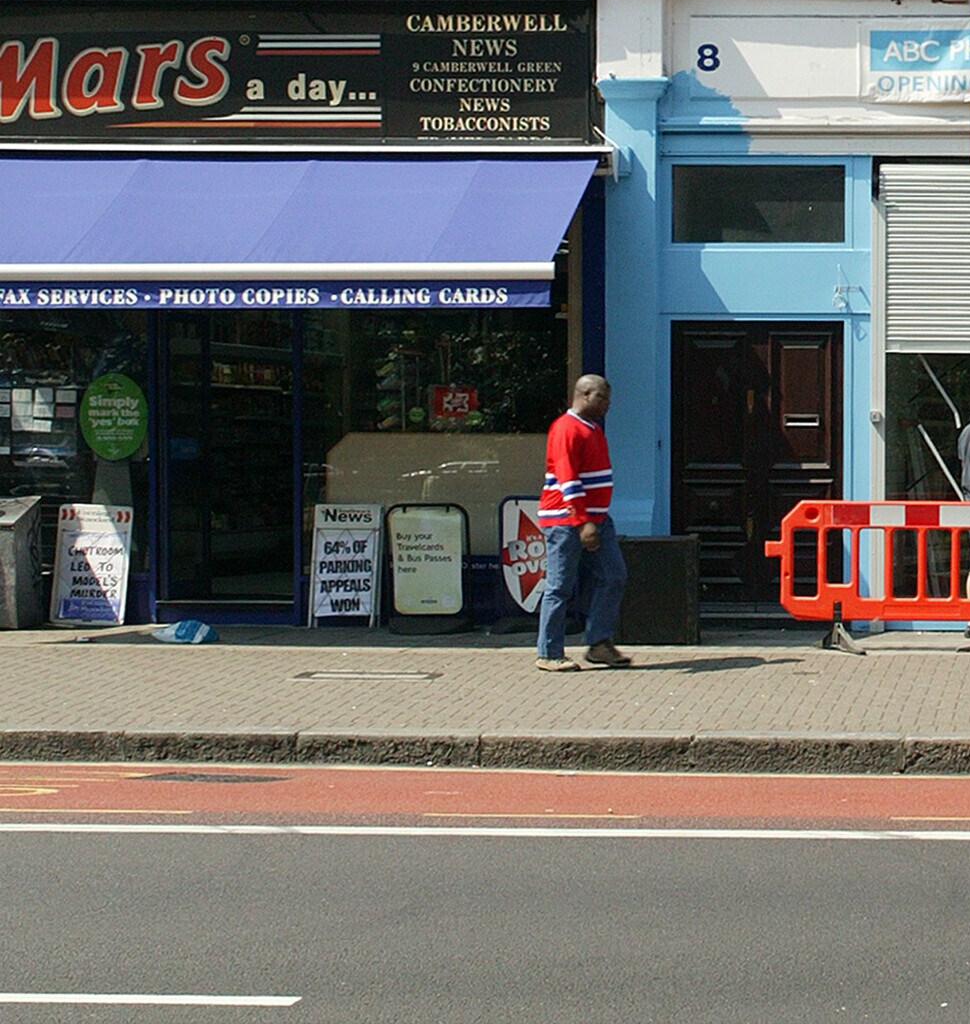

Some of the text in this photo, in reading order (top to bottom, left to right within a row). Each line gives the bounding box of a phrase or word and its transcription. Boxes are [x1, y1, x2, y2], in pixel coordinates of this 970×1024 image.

[406, 14, 568, 32] CAMBERWELL
[452, 39, 518, 57] NEWS
[883, 40, 941, 63] ABC
[697, 43, 721, 72] 8
[412, 61, 562, 73] 9 CAMBERWELL GREEN
[0, 37, 232, 123] Mars
[409, 78, 559, 93] CONFECTIONERY
[246, 78, 265, 100] a
[459, 98, 511, 112] NEWS
[419, 116, 551, 132] TOBACCONISTS
[37, 288, 138, 305] SERVICES
[159, 288, 236, 305] PHOTO
[241, 288, 320, 304] COPIES
[340, 288, 431, 305] CALLING
[438, 287, 509, 304] CARDS
[88, 395, 139, 410] Simply
[88, 408, 140, 417] mark the
[117, 417, 140, 426] box
[324, 508, 373, 523] News
[396, 532, 433, 542] Buy your
[324, 539, 368, 555] 64% OF
[397, 543, 445, 552] Travelcards
[407, 554, 422, 562] Bus
[424, 554, 453, 563] Passes
[70, 561, 114, 573] LED TO
[319, 559, 373, 574] PARKING
[397, 565, 418, 574] here
[320, 578, 371, 594] APPEALS
[330, 597, 360, 613] WON
